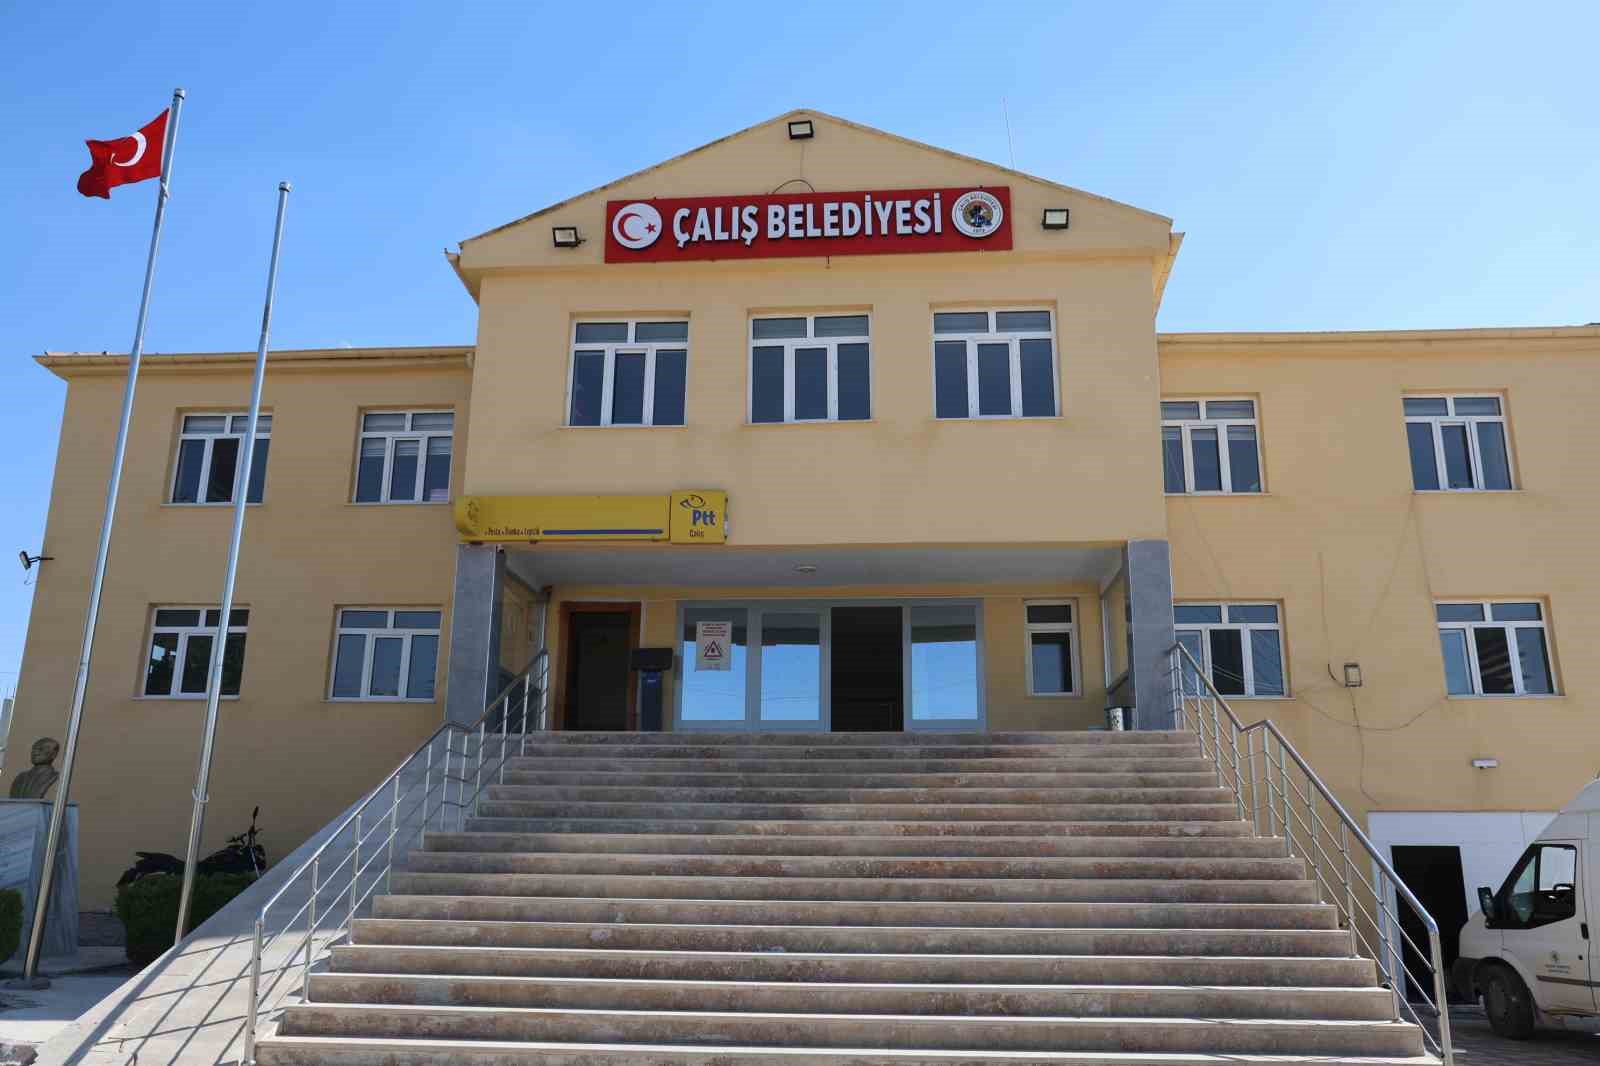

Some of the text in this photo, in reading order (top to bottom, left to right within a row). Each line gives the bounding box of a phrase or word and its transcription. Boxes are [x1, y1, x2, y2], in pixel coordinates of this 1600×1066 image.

[672, 204, 759, 249] ÇALIŞ
[767, 192, 942, 239] BELEDİYESİ
[692, 509, 716, 526] Ptt
